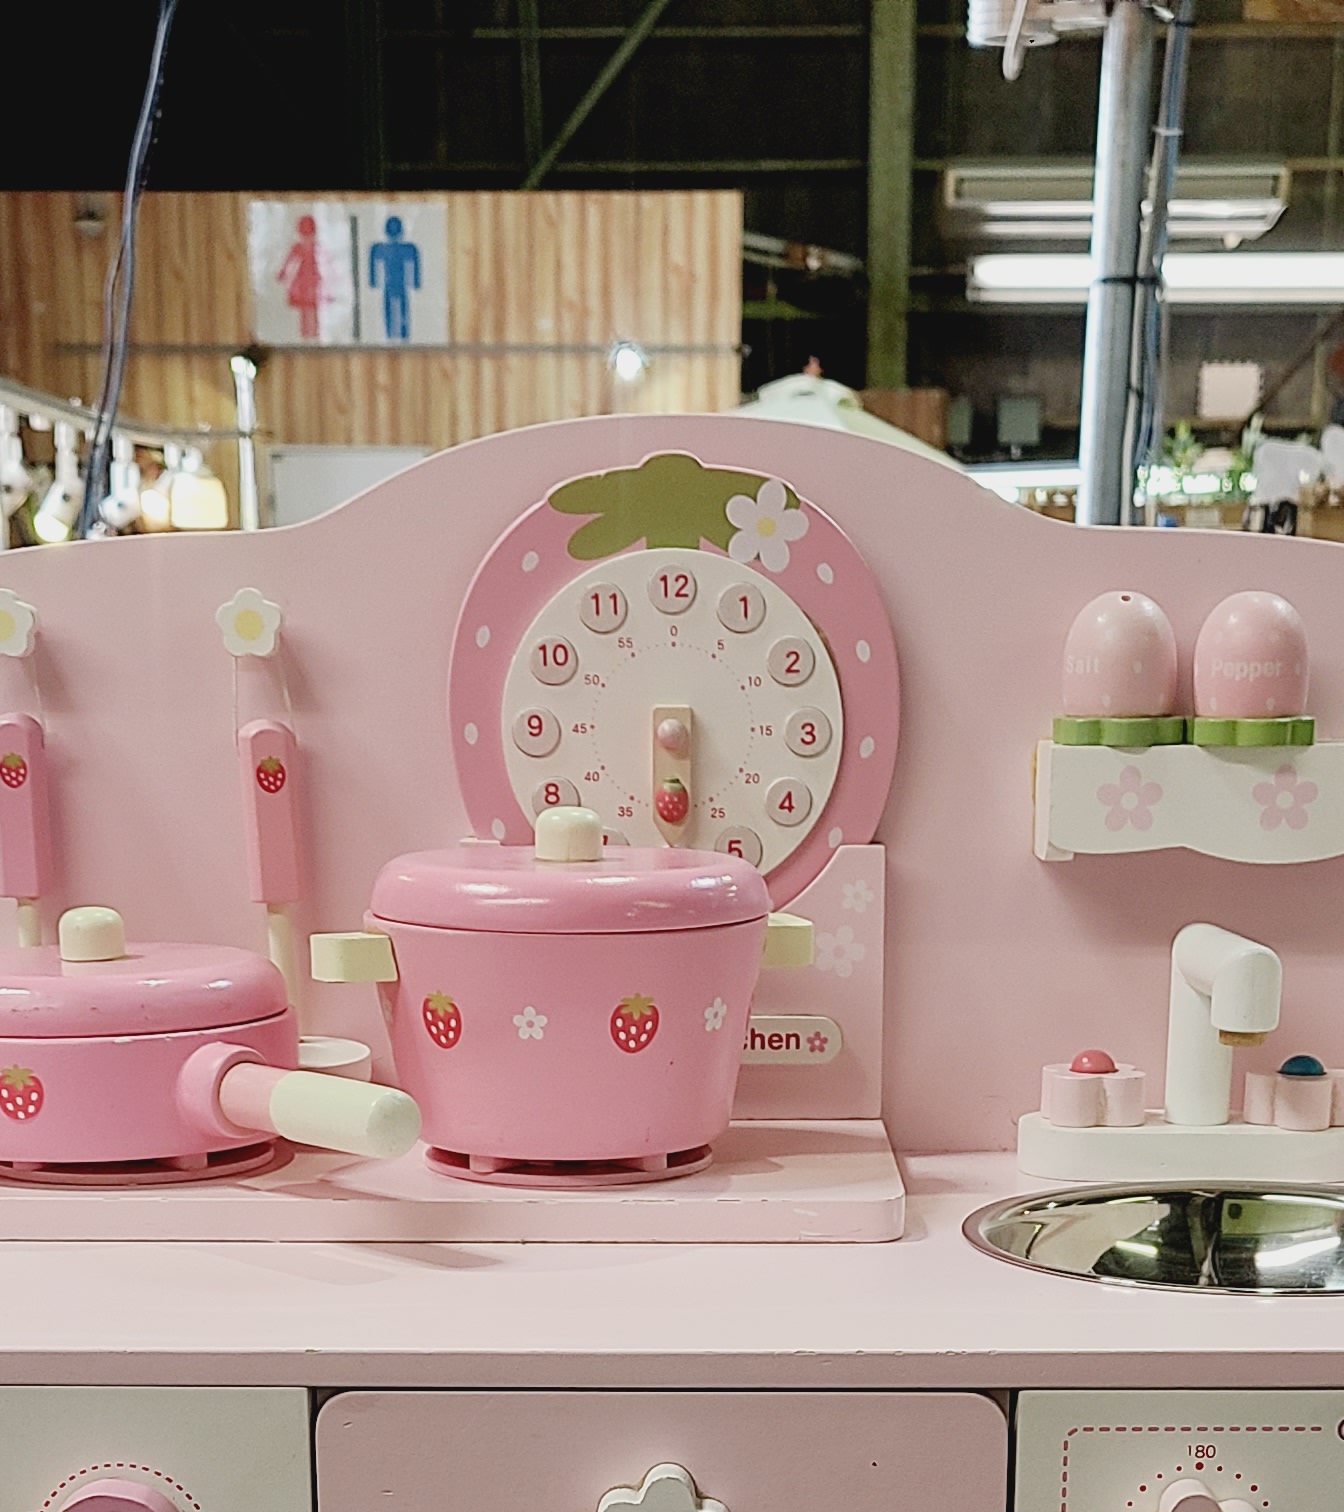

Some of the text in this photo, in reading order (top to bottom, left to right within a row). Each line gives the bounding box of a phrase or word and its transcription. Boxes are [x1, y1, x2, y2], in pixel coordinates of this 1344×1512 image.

[659, 574, 689, 599] 12
[591, 593, 619, 616] 11
[738, 595, 749, 619] 1
[669, 625, 679, 637] 0
[617, 637, 634, 649] 55
[717, 639, 725, 651] 5
[538, 643, 570, 667] 10
[784, 651, 801, 674] 2
[1065, 655, 1101, 674] Salt
[1211, 658, 1284, 683] Pepper
[583, 674, 600, 686] 50
[747, 676, 762, 688] 10
[527, 714, 544, 737] 9
[571, 724, 588, 735] 45
[759, 725, 773, 737] 15
[800, 722, 817, 746] 3
[584, 771, 600, 783] 40
[744, 773, 760, 785] 20
[544, 783, 561, 806] 8
[778, 791, 796, 813] 4
[617, 807, 634, 818] 35
[710, 807, 726, 819] 25
[728, 839, 743, 858] 5
[1187, 1444, 1217, 1459] 180
